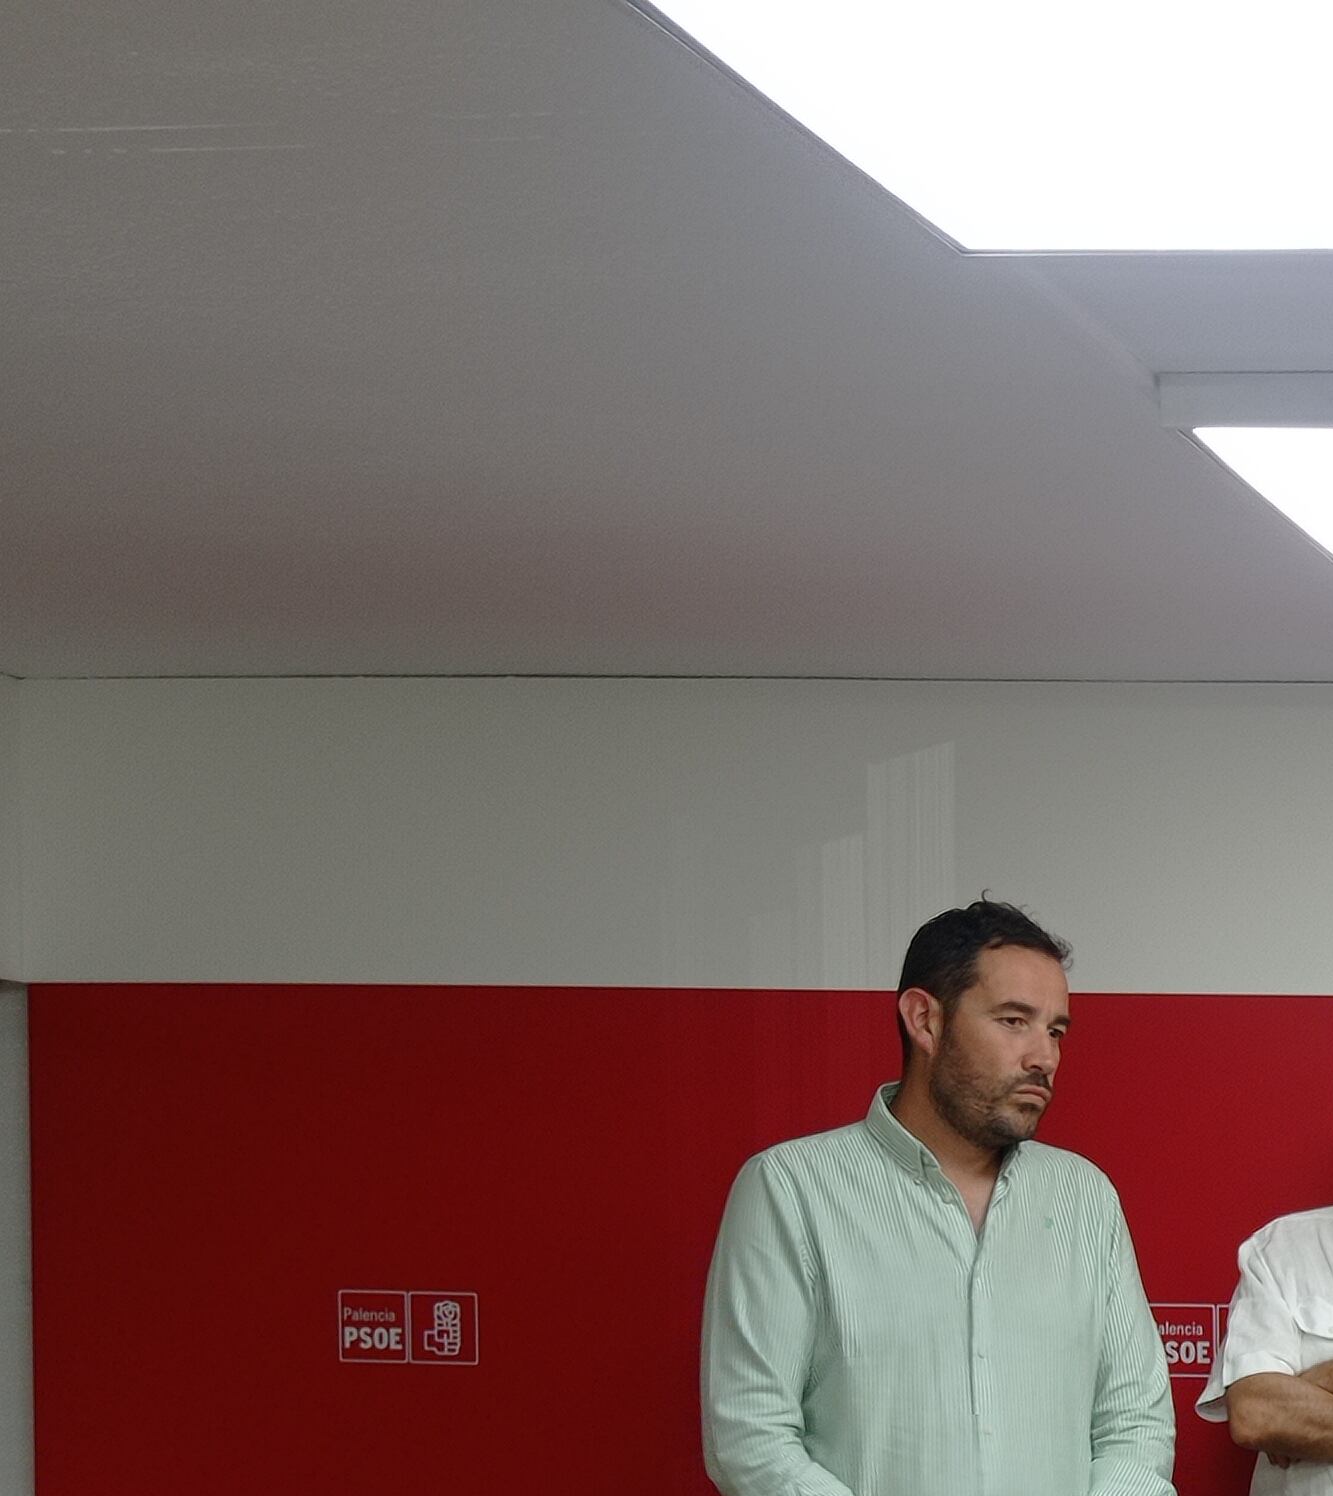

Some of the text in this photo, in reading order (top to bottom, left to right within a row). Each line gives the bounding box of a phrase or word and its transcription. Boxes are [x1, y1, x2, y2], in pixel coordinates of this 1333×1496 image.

[343, 1307, 396, 1322] Palencia
[343, 1326, 402, 1350] PSOE
[1159, 1321, 1204, 1336] alencia
[1165, 1341, 1211, 1364] SOE
